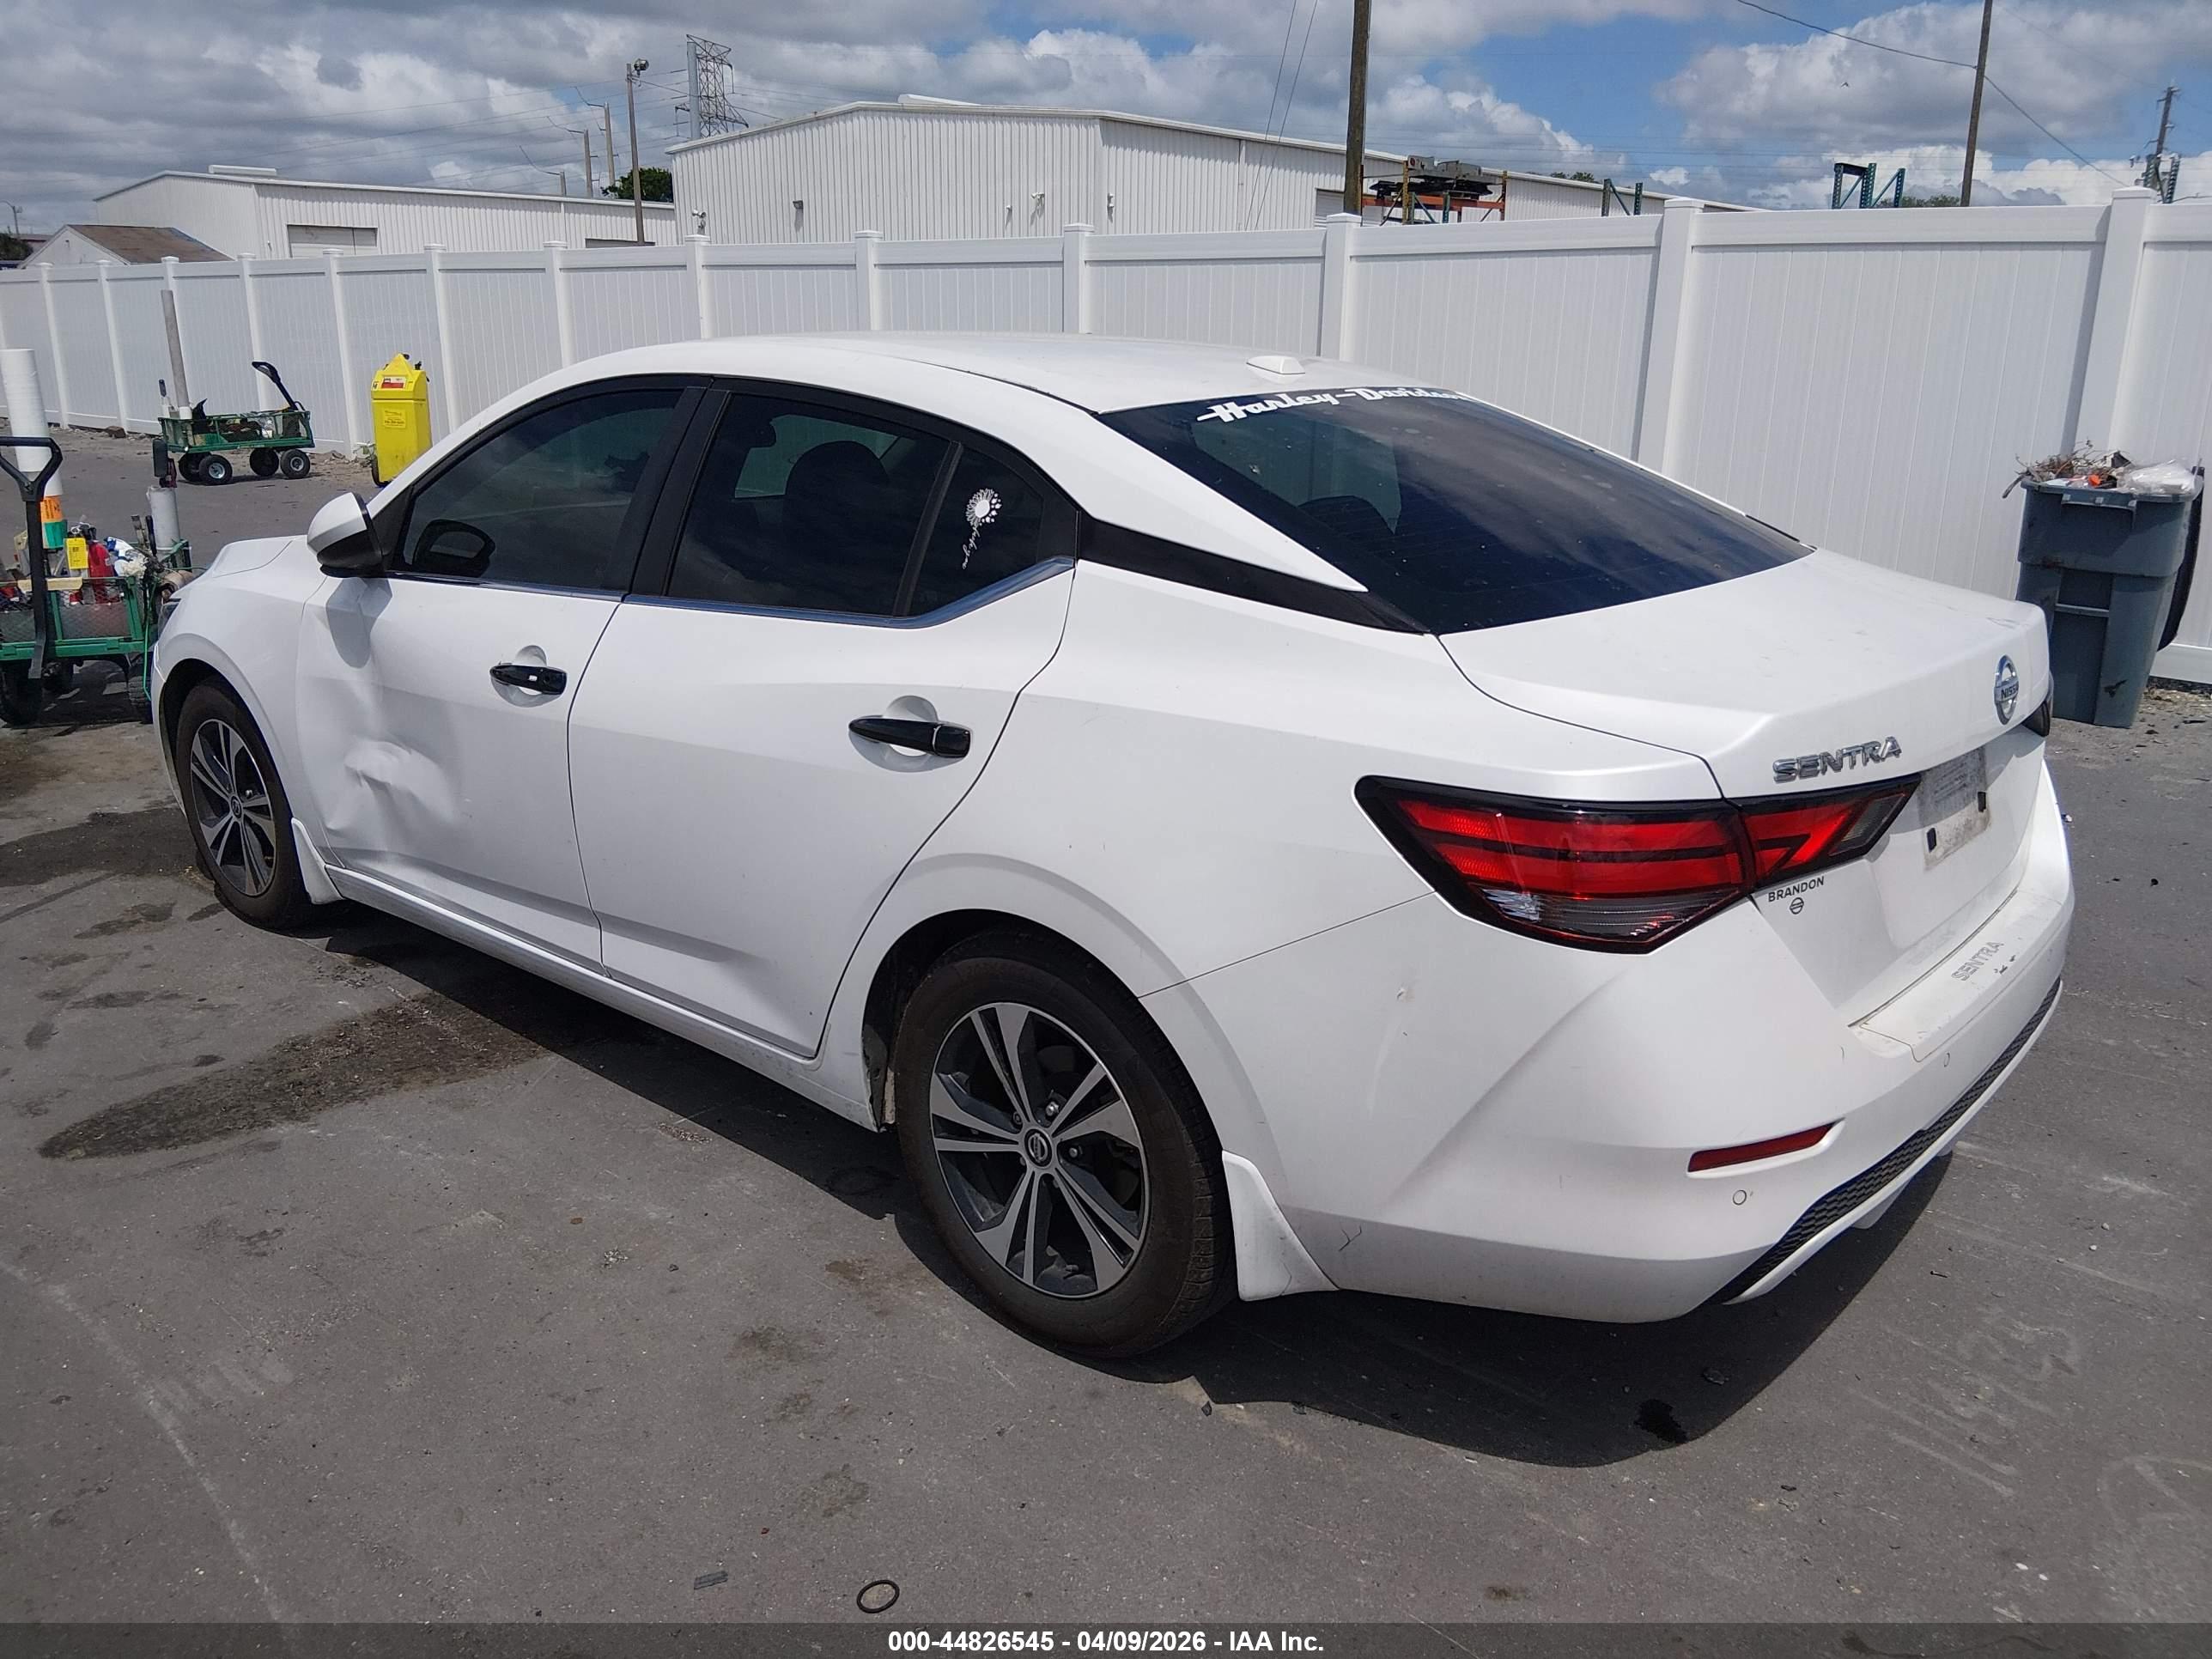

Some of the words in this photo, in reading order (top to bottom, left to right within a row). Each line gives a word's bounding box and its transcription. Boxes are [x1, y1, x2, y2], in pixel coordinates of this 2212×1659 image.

[2001, 681, 2019, 700] NISS
[1772, 736, 1903, 783] SENTRA
[1767, 876, 1825, 902] BRANDON
[1949, 941, 2004, 980] SENTRA
